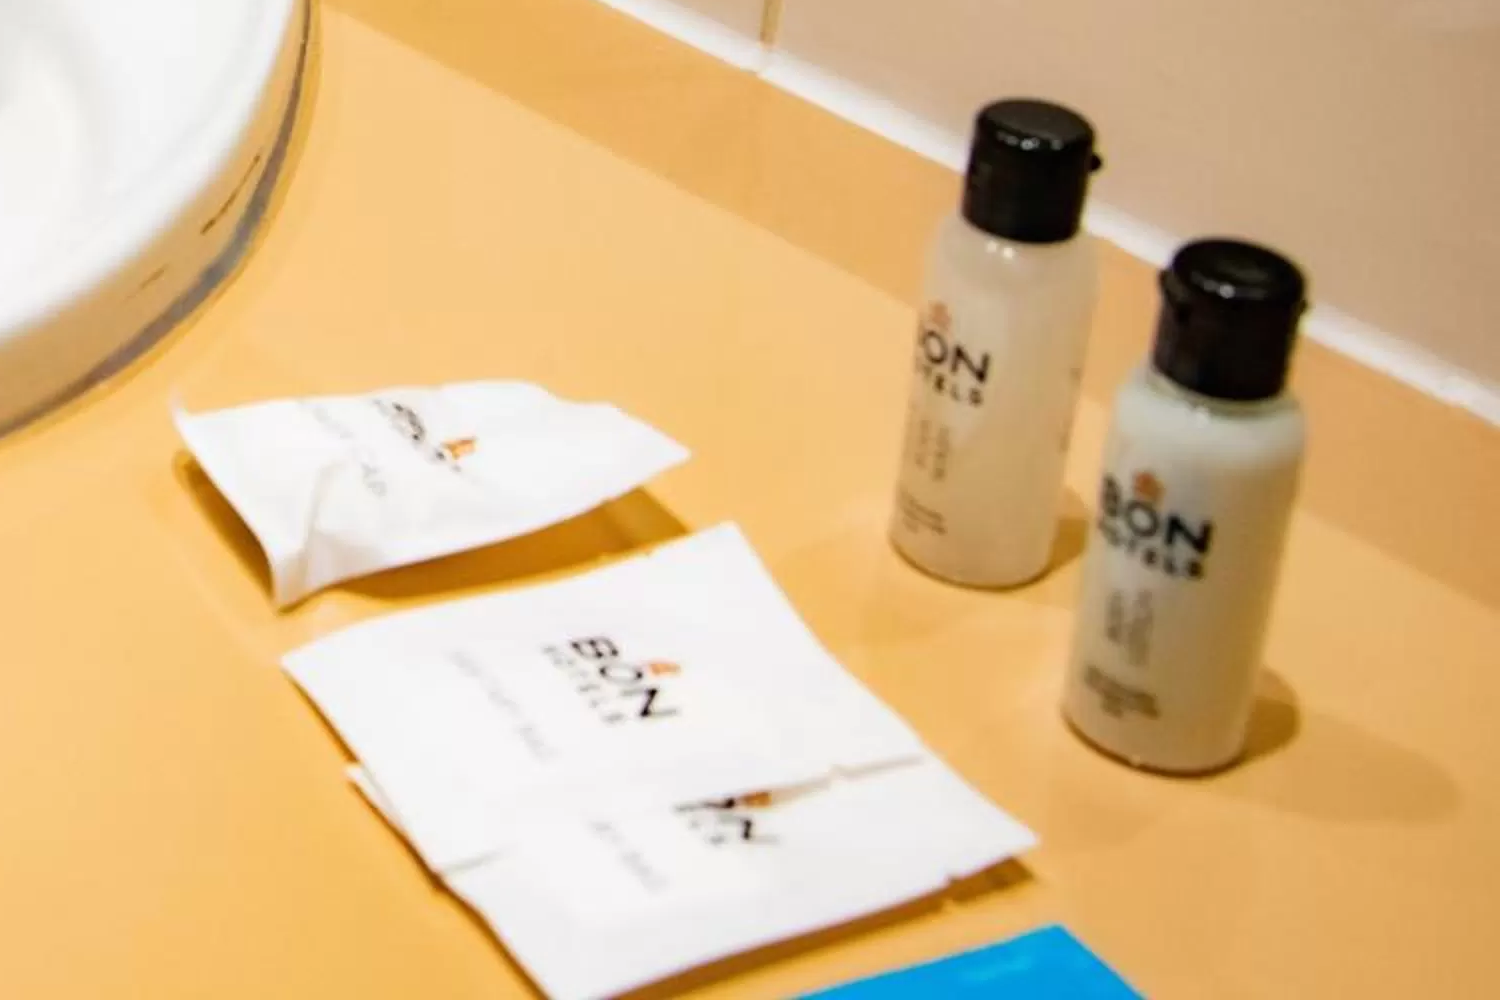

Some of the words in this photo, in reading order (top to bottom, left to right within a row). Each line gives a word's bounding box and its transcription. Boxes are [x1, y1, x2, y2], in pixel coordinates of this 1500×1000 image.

[919, 327, 990, 385] ON
[1102, 473, 1214, 555] BON
[570, 635, 681, 718] BON
